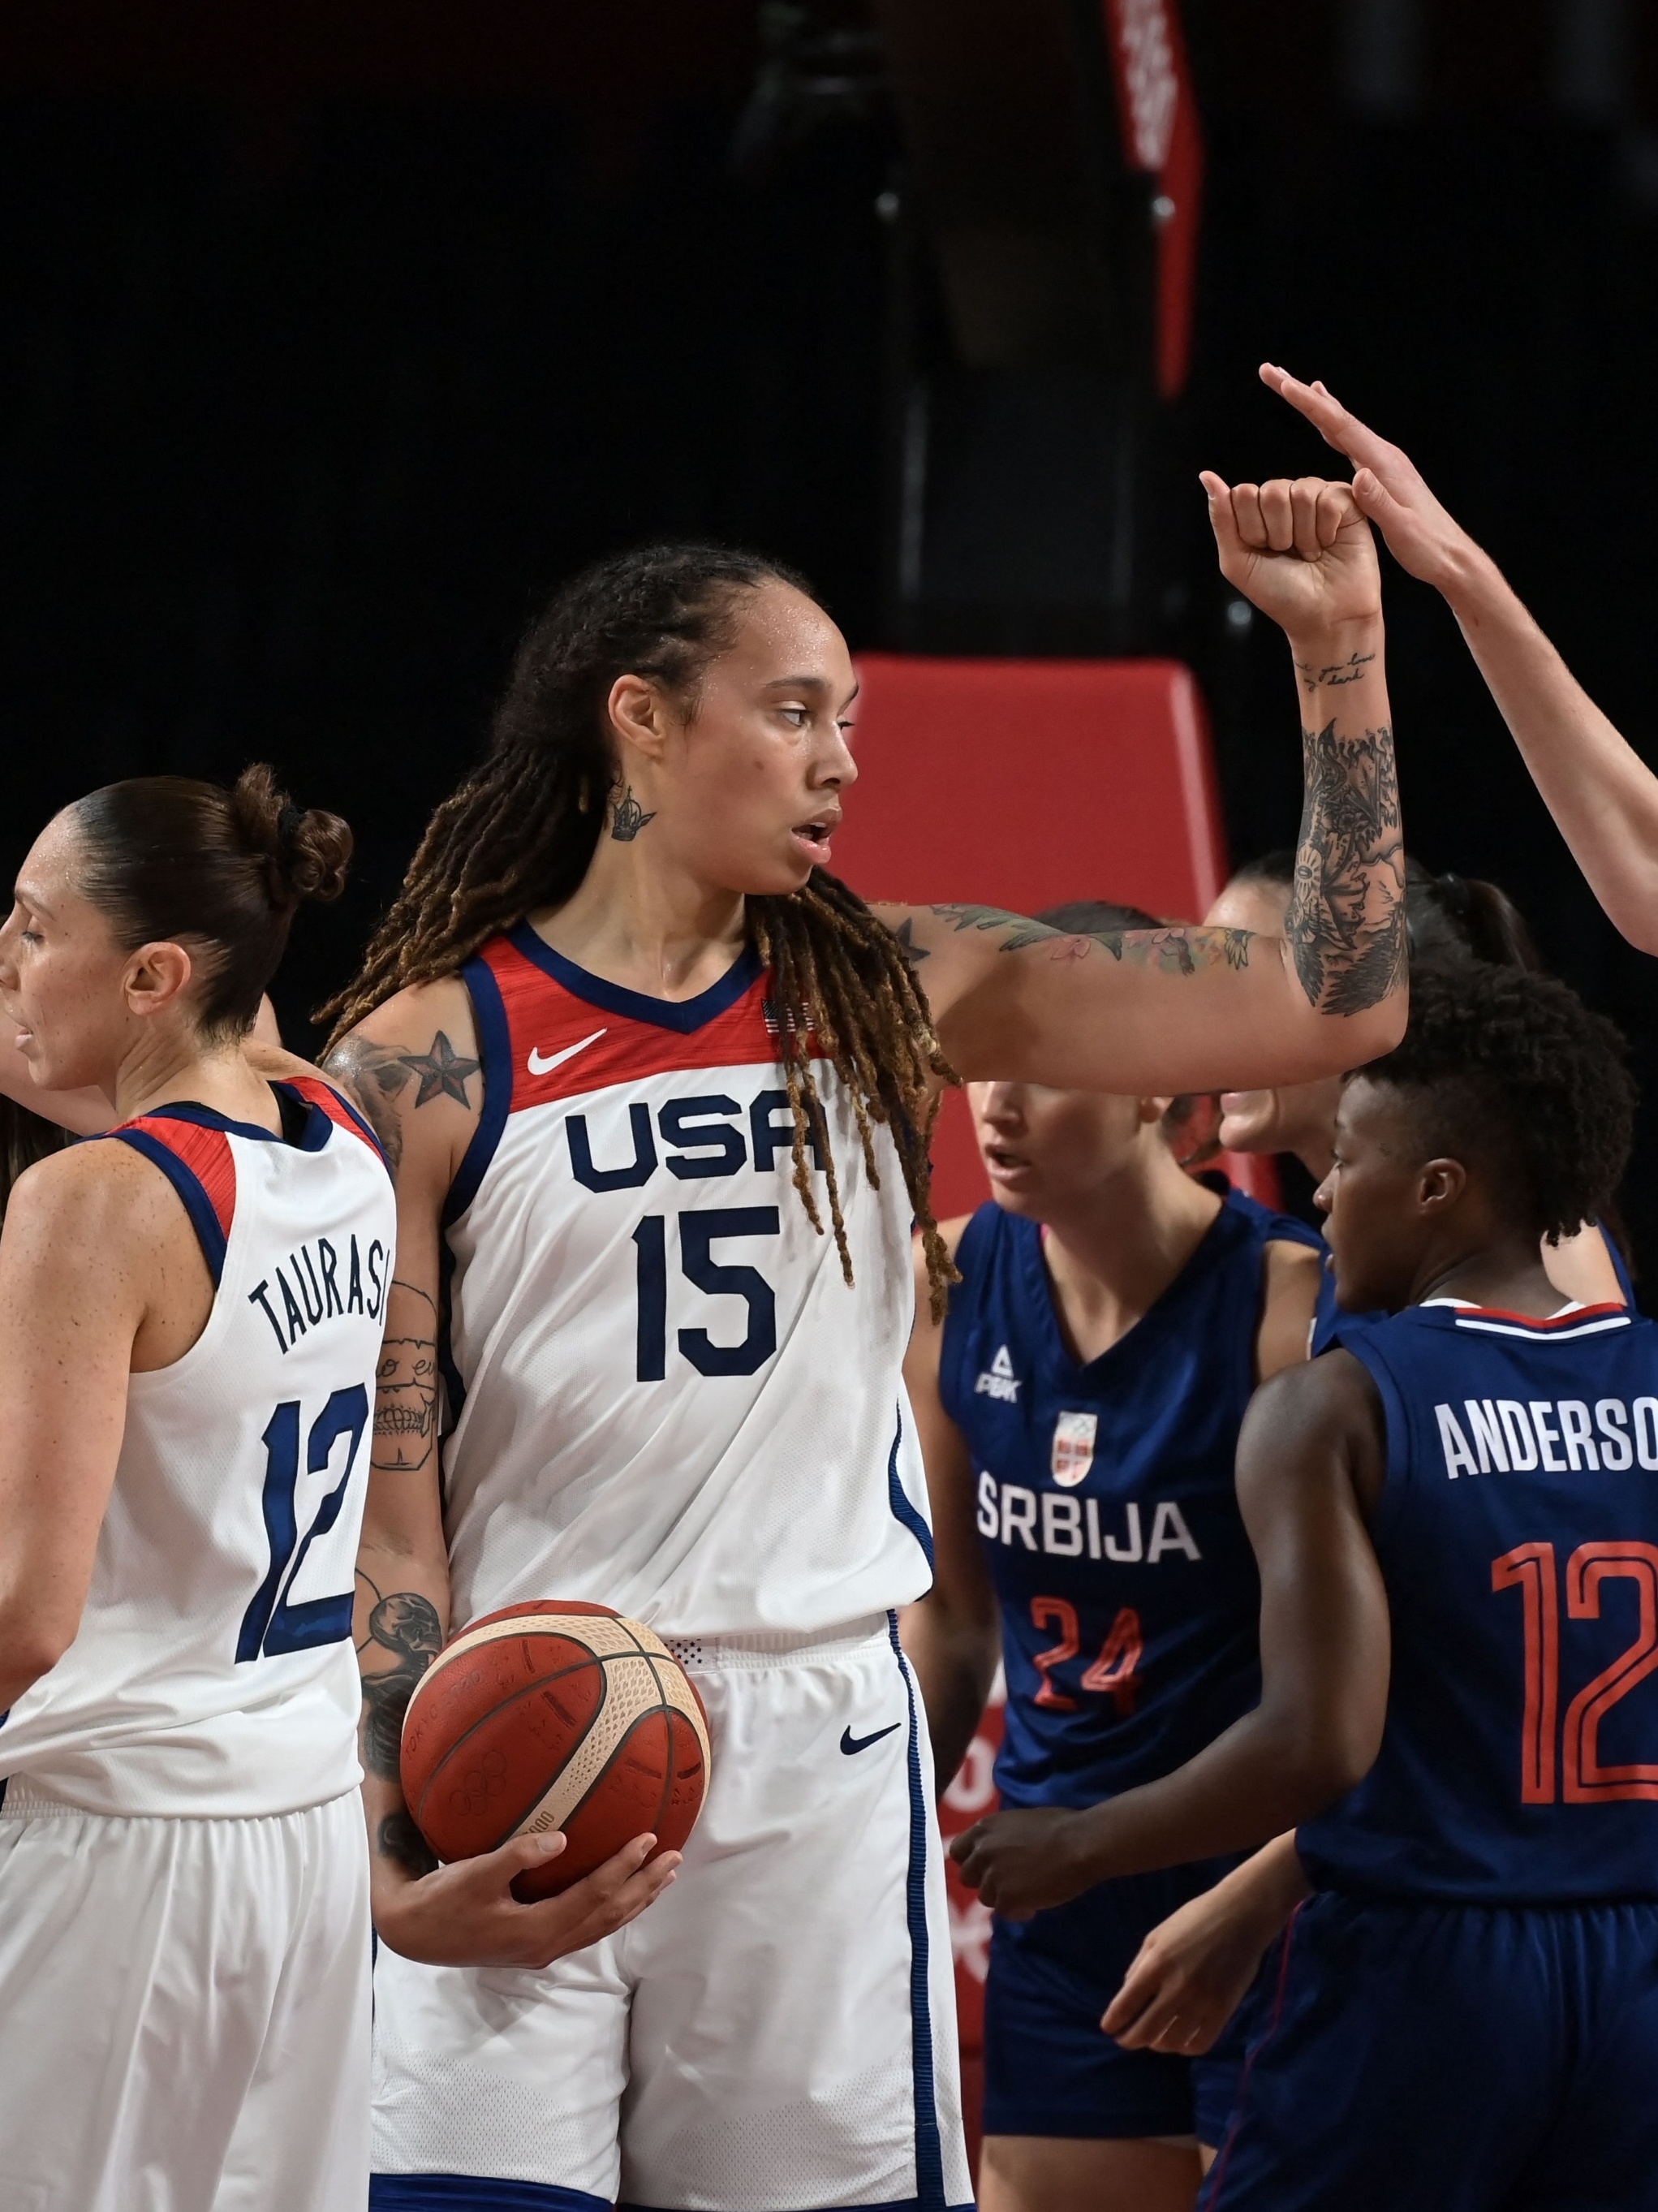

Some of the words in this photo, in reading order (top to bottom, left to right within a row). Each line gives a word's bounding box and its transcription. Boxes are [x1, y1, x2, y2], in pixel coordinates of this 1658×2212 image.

[565, 1089, 833, 1194] USA
[631, 1205, 781, 1382] 15
[235, 1382, 369, 1664] 12
[976, 1470, 1202, 1563] SRBIJA
[1030, 1596, 1143, 1713] 24
[1491, 1540, 1658, 1805] 12
